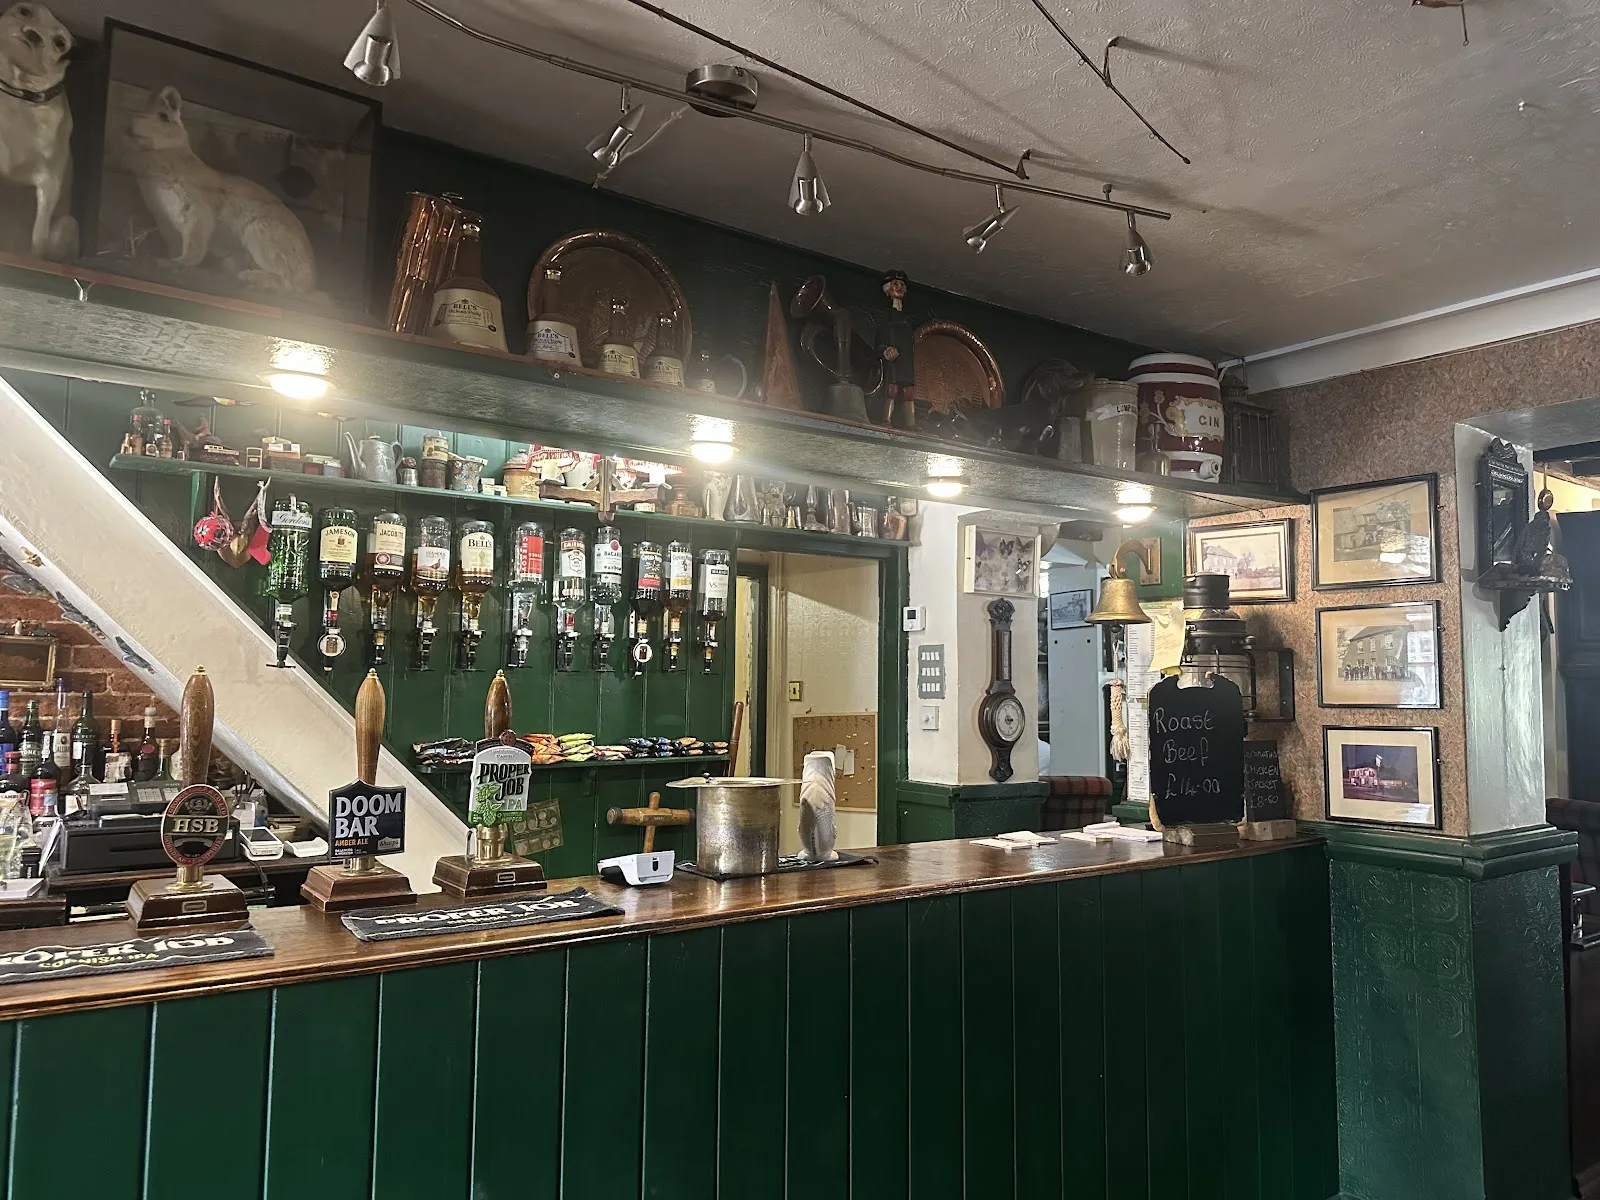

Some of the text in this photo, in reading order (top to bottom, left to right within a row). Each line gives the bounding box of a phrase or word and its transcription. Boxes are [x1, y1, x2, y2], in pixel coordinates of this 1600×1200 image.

[453, 303, 477, 311] BELL'S
[1198, 414, 1220, 428] GIN
[324, 527, 356, 539] JAMESON
[467, 537, 493, 548] BELL'S
[1153, 706, 1215, 734] Roast
[1162, 736, 1209, 767] Beef
[476, 762, 530, 785] PROPER
[494, 777, 524, 801] JOB
[335, 792, 402, 818] DOOM
[172, 818, 220, 833] HSB
[335, 815, 380, 838] BAR
[335, 838, 369, 847] AMBER ALE
[375, 899, 580, 926] PROPER JOB
[153, 936, 235, 953] JOB
